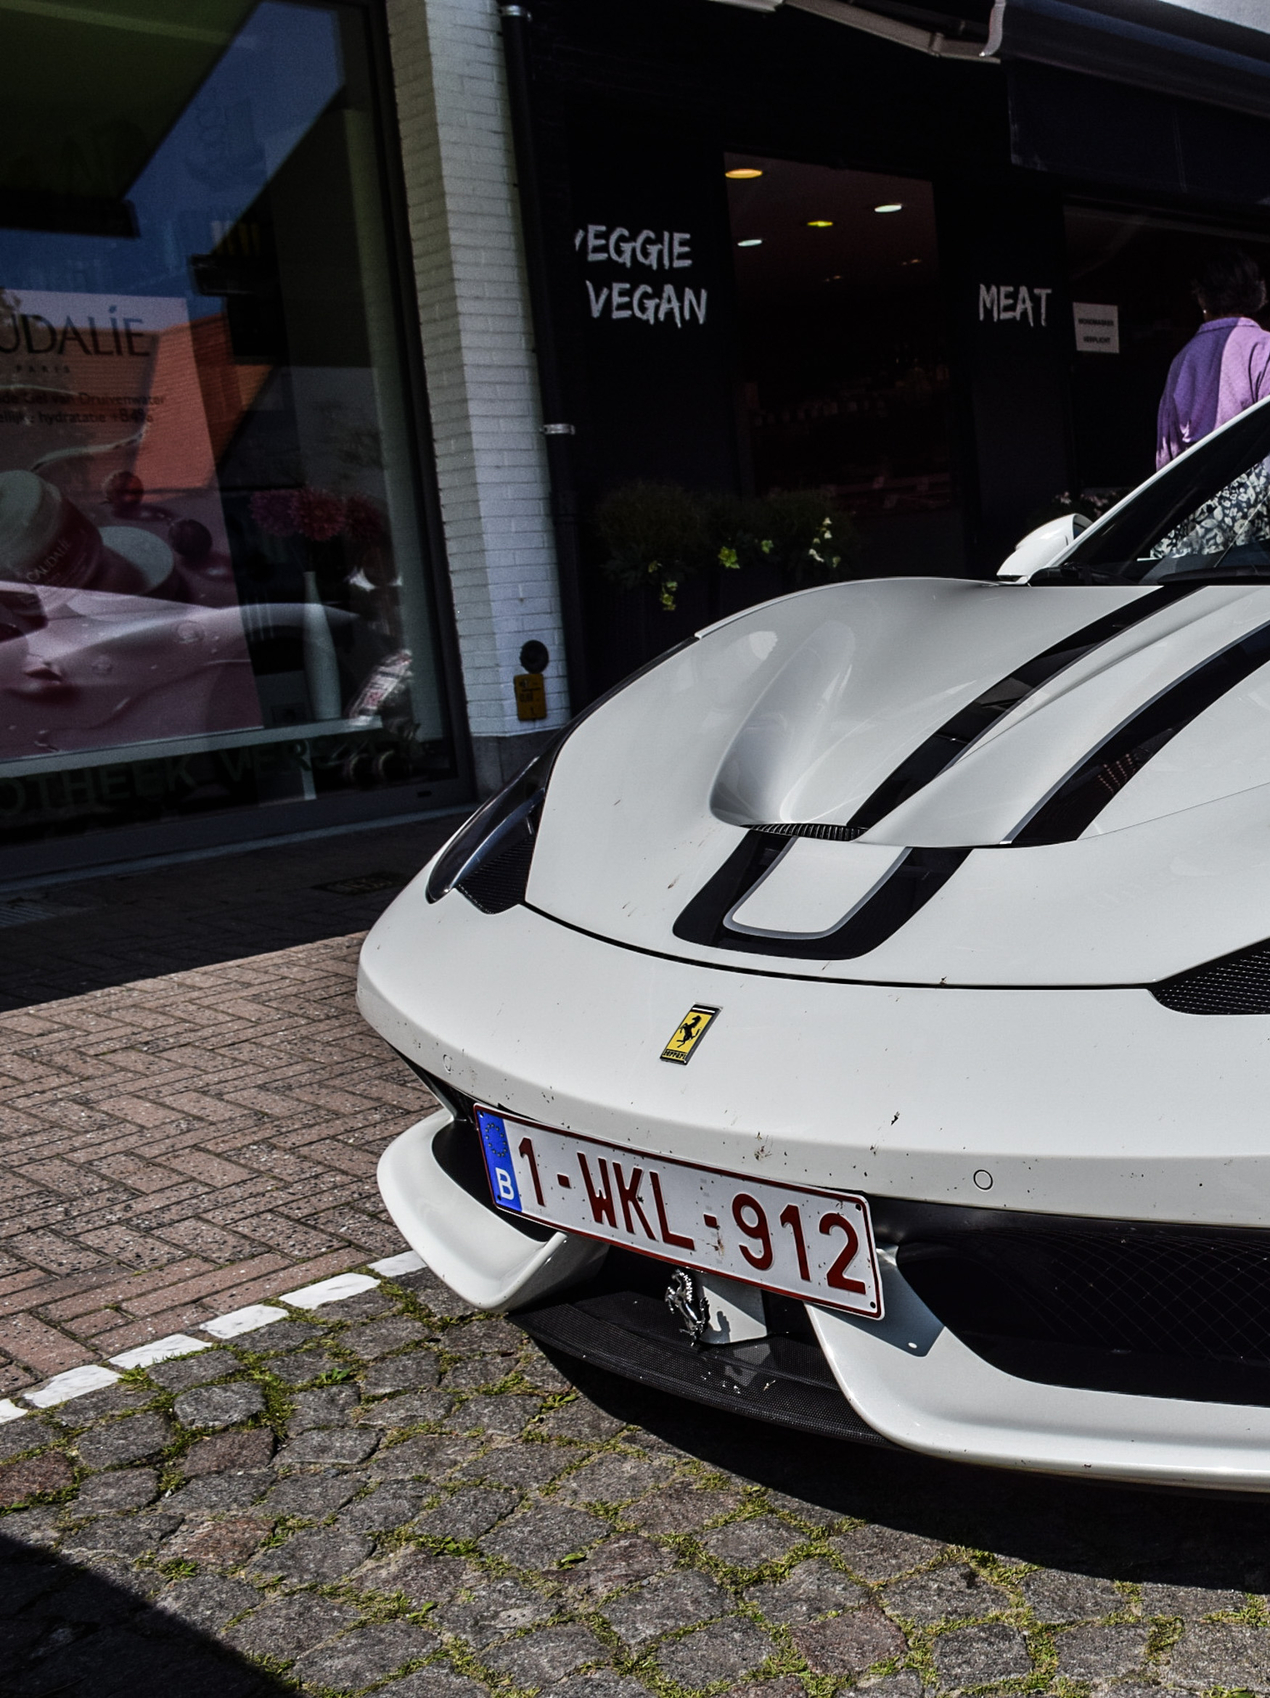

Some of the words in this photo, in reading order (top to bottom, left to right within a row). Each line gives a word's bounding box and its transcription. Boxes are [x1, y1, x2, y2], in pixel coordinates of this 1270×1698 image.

[584, 279, 708, 330] VEGAN
[978, 282, 1053, 328] MEAT
[16, 364, 71, 374] PARIS
[52, 395, 74, 405] van
[38, 411, 107, 427] hydratatie
[495, 1166, 514, 1201] B
[518, 1136, 867, 1296] 1-WKL-912
